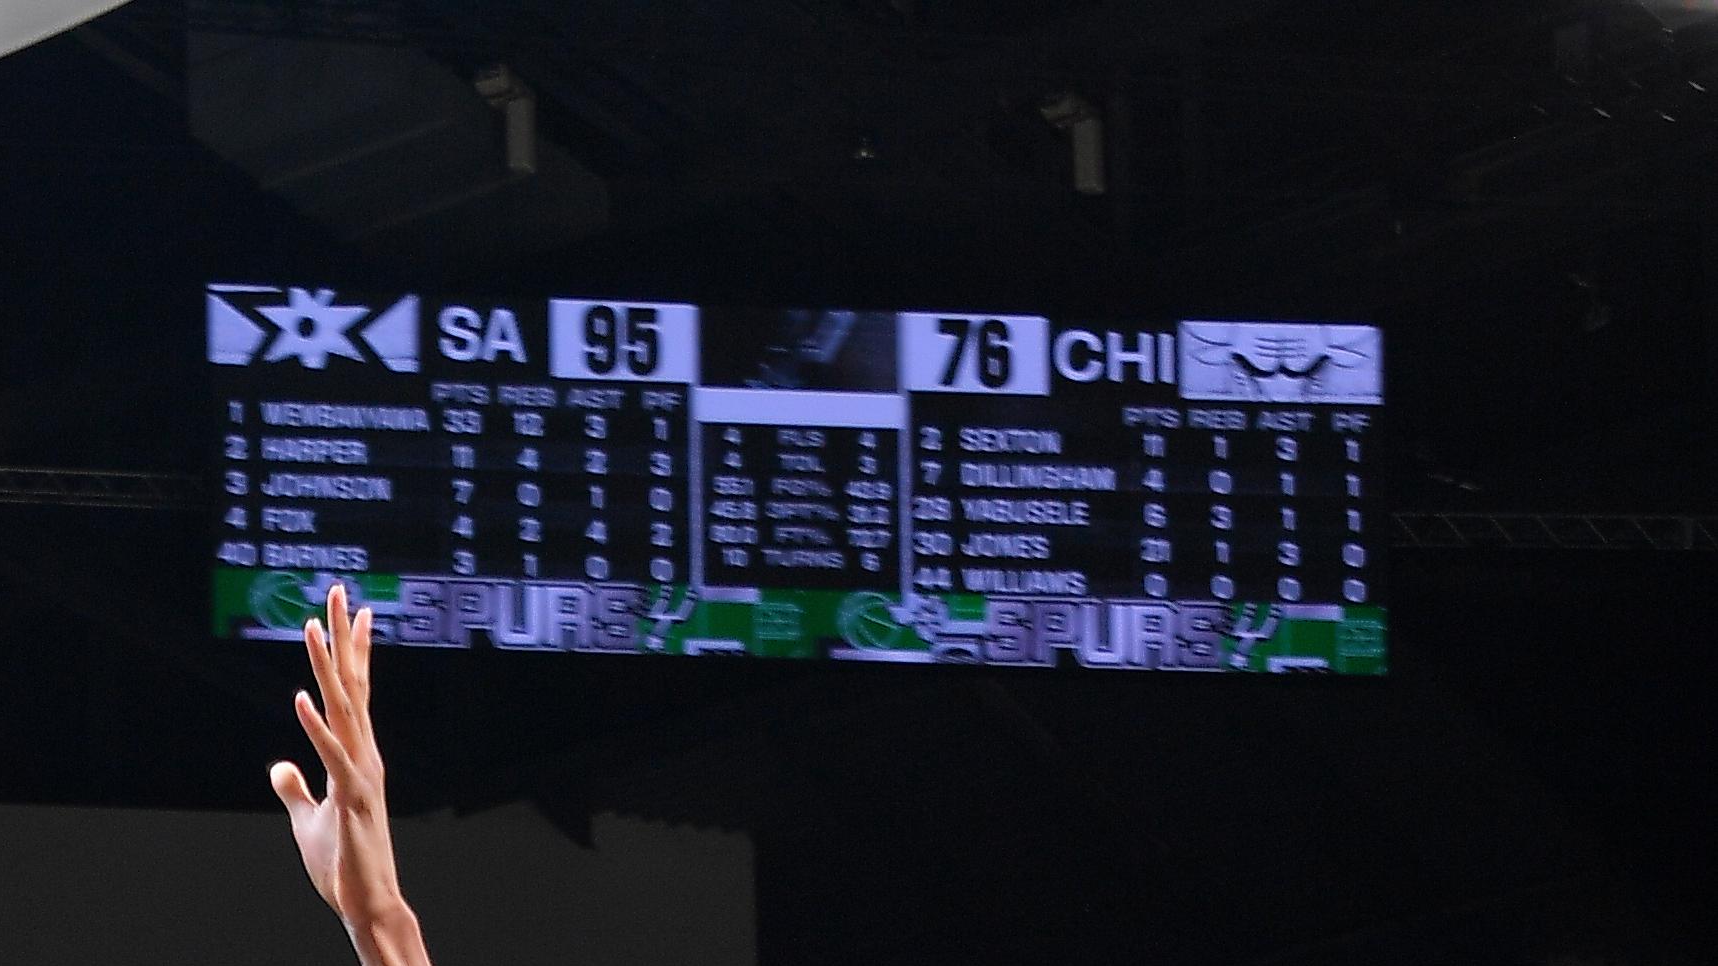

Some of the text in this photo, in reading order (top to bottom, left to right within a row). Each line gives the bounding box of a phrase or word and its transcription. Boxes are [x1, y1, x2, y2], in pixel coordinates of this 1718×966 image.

[437, 306, 528, 364] SA
[583, 304, 660, 376] 95
[938, 318, 1012, 388] 76
[1053, 328, 1176, 385] CHI
[584, 414, 607, 439] 3
[652, 417, 669, 441] 1
[920, 426, 943, 450] 2
[1213, 435, 1229, 460] 1
[1275, 436, 1298, 461] 3
[1344, 438, 1361, 462] 1
[224, 434, 249, 460] 2
[516, 447, 539, 471] 4
[584, 449, 608, 475] 2
[650, 452, 672, 477] 3
[224, 470, 673, 512] 3 JOHNSON 7 0 1 0
[920, 461, 943, 485] 7
[1141, 467, 1165, 492] 4
[1208, 470, 1232, 495] 0
[1280, 472, 1295, 496] 1
[1345, 474, 1361, 498] 1
[224, 506, 248, 530] 4
[261, 506, 316, 533] FOX
[451, 515, 474, 539] 4
[585, 520, 608, 544] 4
[1210, 504, 1233, 530] 3
[1280, 507, 1296, 531] 1
[1346, 509, 1362, 533] 1
[452, 550, 476, 575] 3
[523, 553, 538, 577] 1
[585, 555, 609, 580] 0
[650, 557, 674, 582] 0
[960, 532, 1050, 559] JONES
[1215, 540, 1231, 564] 1
[1277, 541, 1300, 567] 3
[1342, 543, 1366, 569] 0
[1144, 573, 1168, 598] 0
[1210, 574, 1235, 600] 0
[1277, 576, 1301, 602] 0
[1343, 578, 1367, 603] 0
